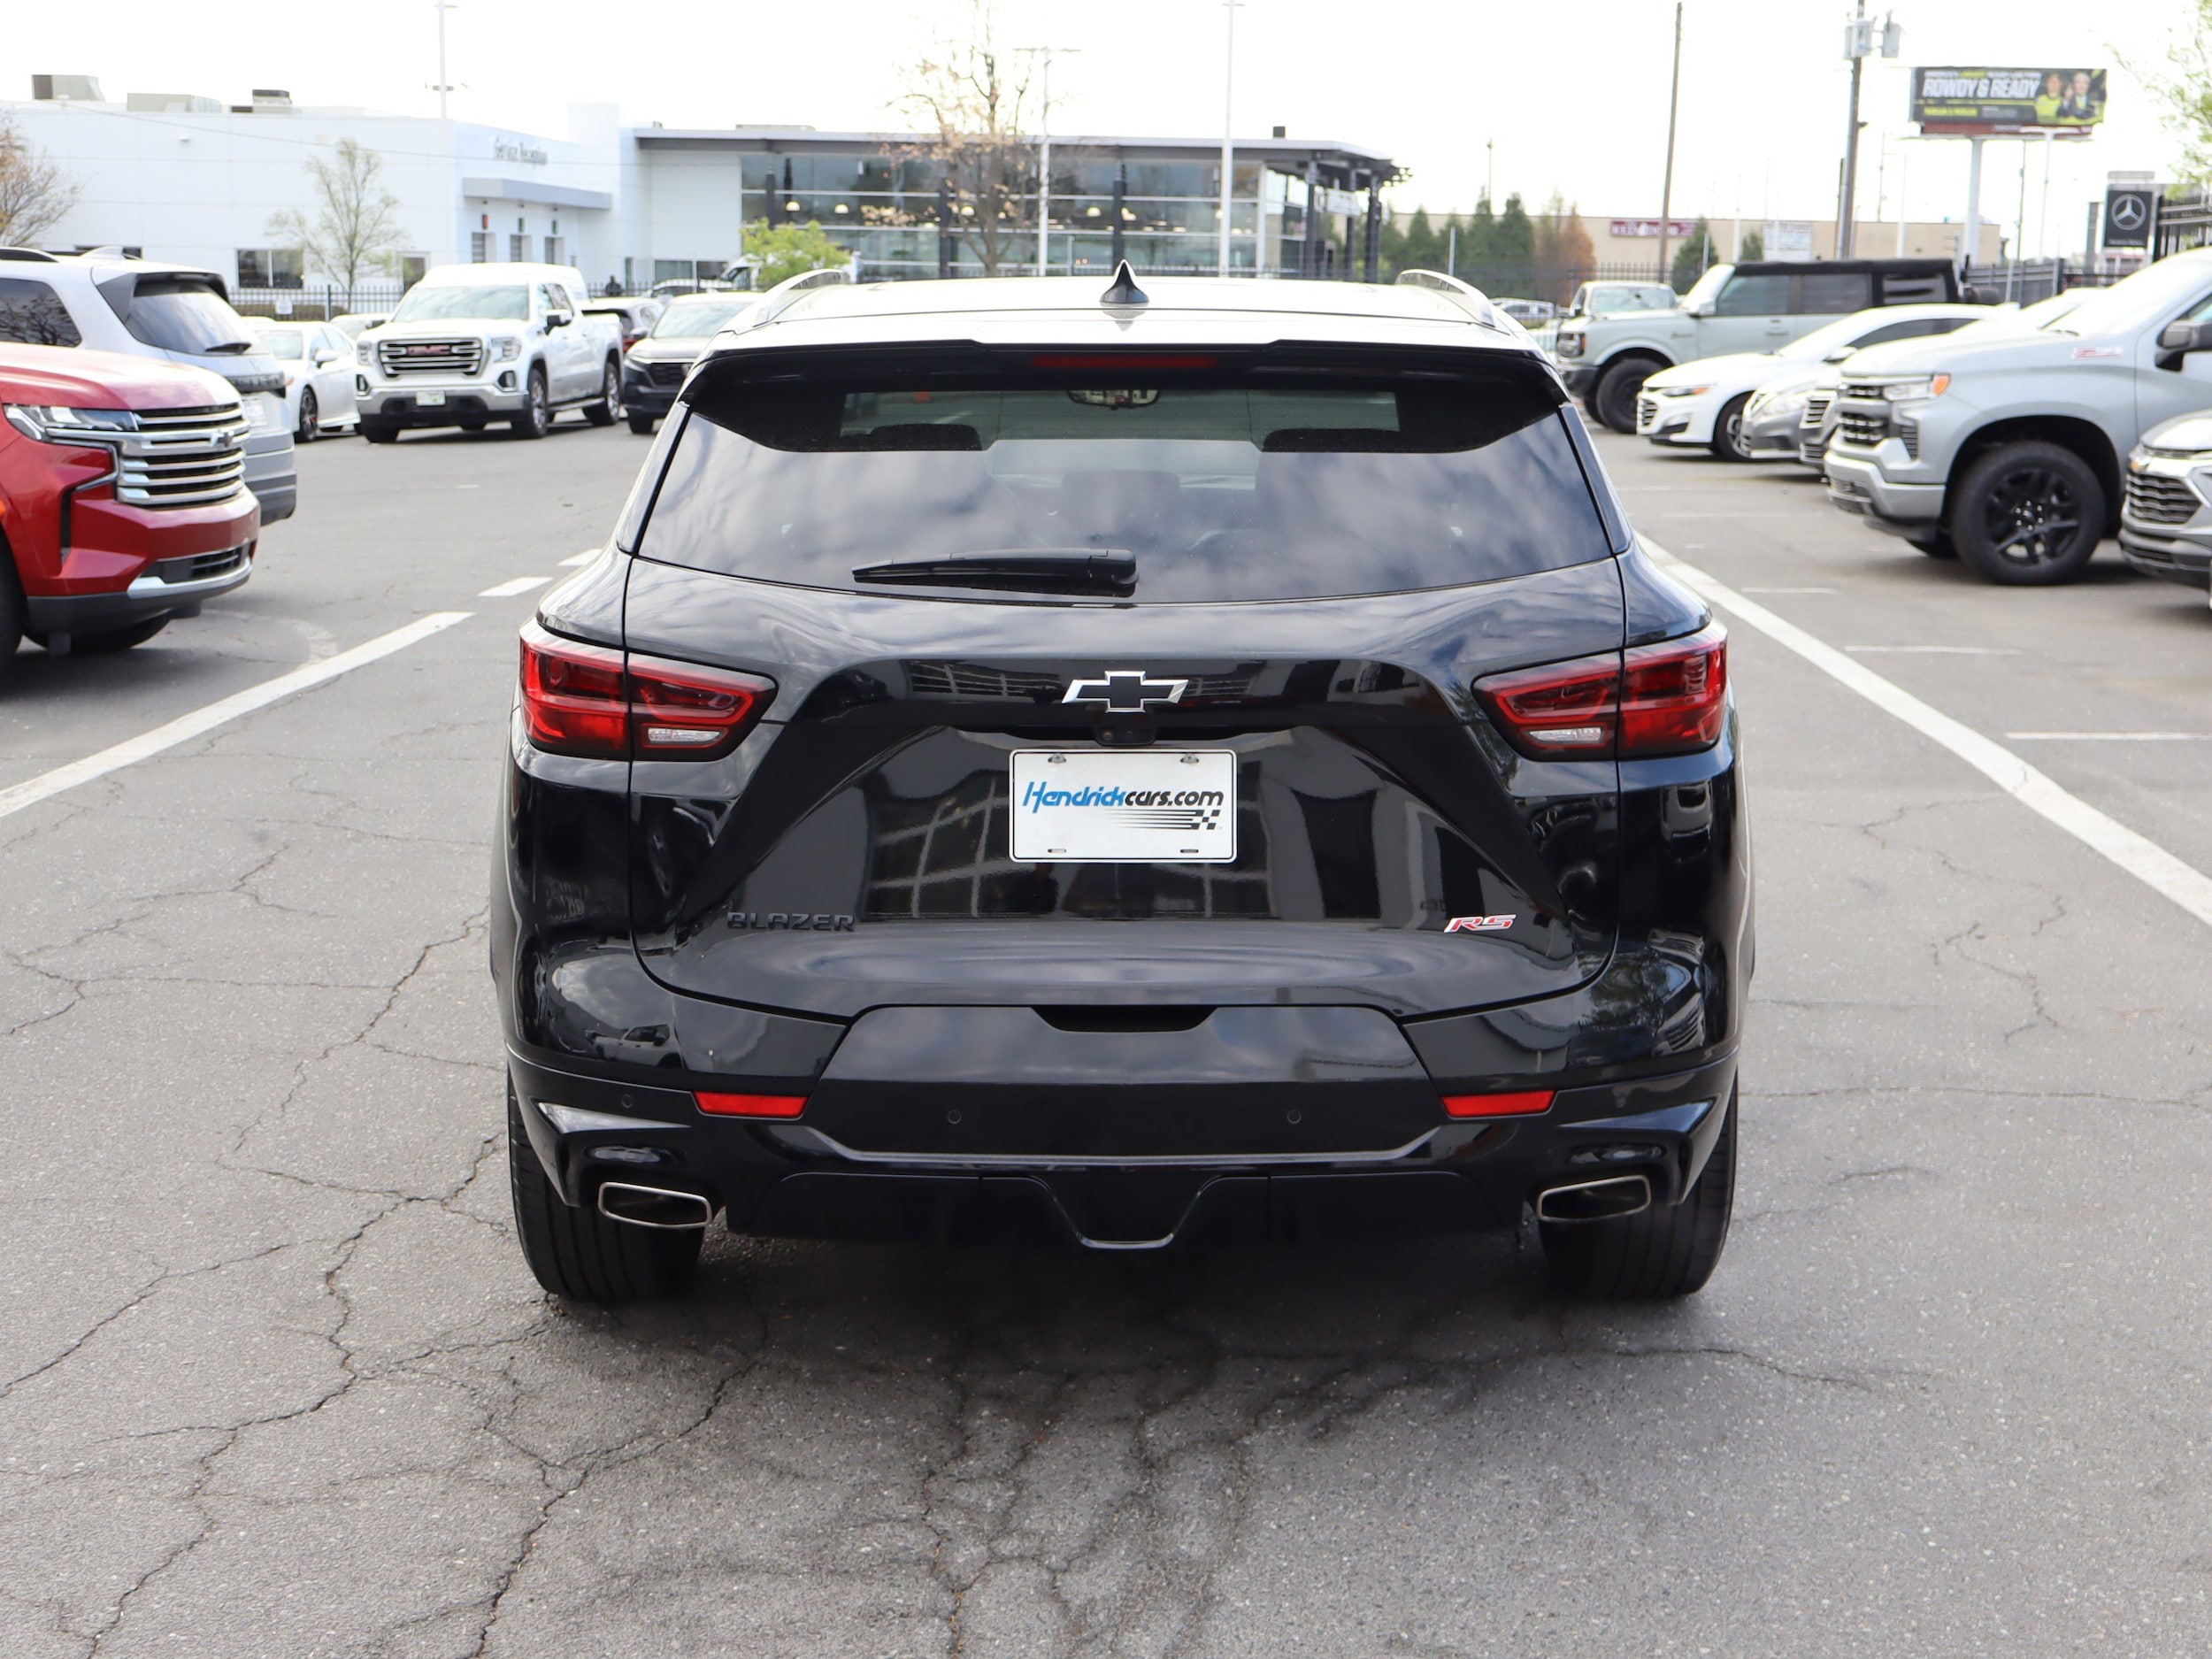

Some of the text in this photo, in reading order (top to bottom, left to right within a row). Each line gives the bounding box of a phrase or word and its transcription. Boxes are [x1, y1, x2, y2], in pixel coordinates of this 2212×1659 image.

[1990, 78, 2040, 99] READY
[1022, 781, 1224, 814] Hendrickcars.com
[726, 911, 855, 933] BLAZER
[1443, 913, 1517, 933] RS
